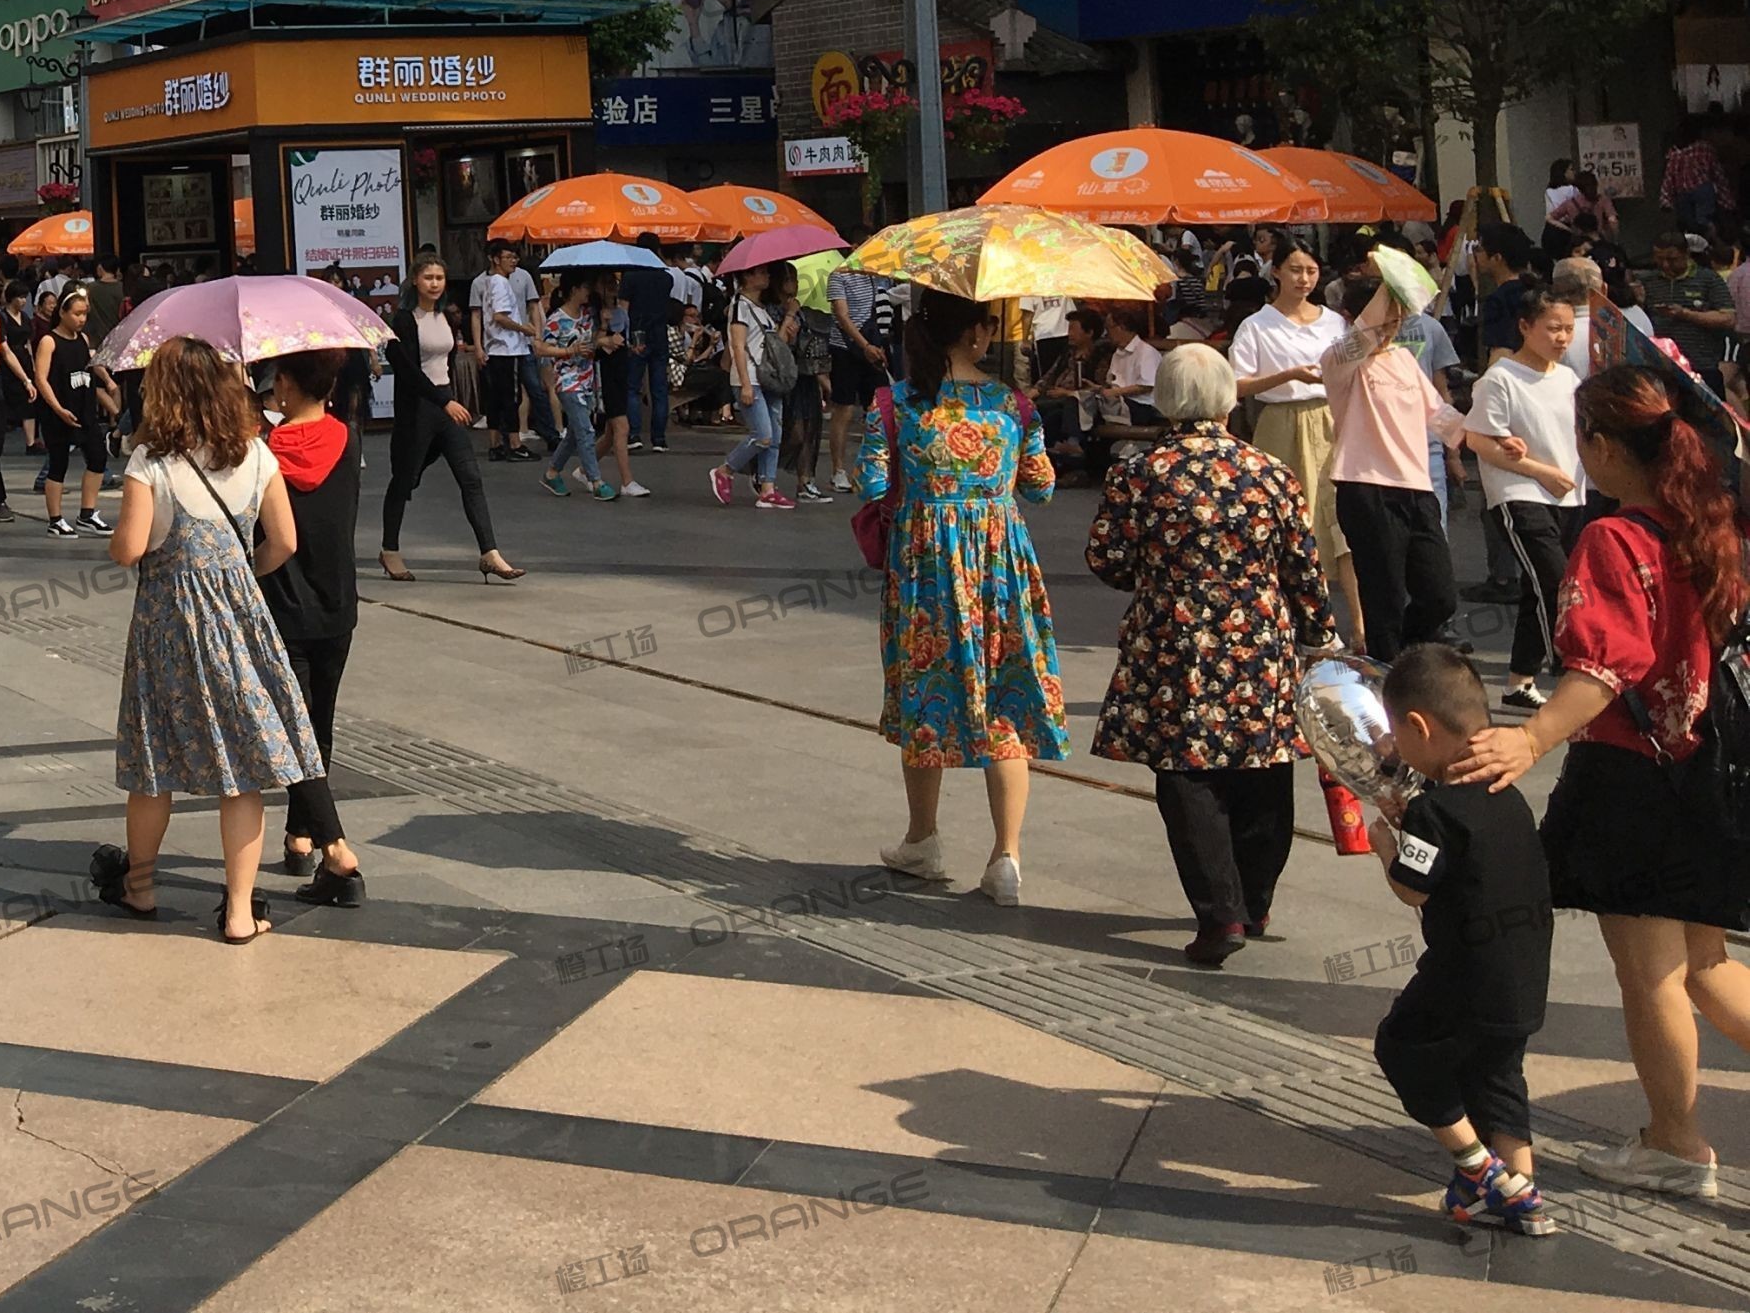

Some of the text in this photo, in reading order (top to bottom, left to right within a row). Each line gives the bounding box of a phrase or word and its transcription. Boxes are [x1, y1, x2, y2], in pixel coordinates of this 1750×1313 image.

[358, 55, 496, 88] 群丽婚纱
[164, 72, 230, 116] 群丽婚纱
[354, 90, 506, 104] QUNLI WEDDING PHOTO
[350, 167, 402, 202] Photo
[320, 203, 380, 221] 群丽婚纱
[1403, 844, 1428, 864] GB
